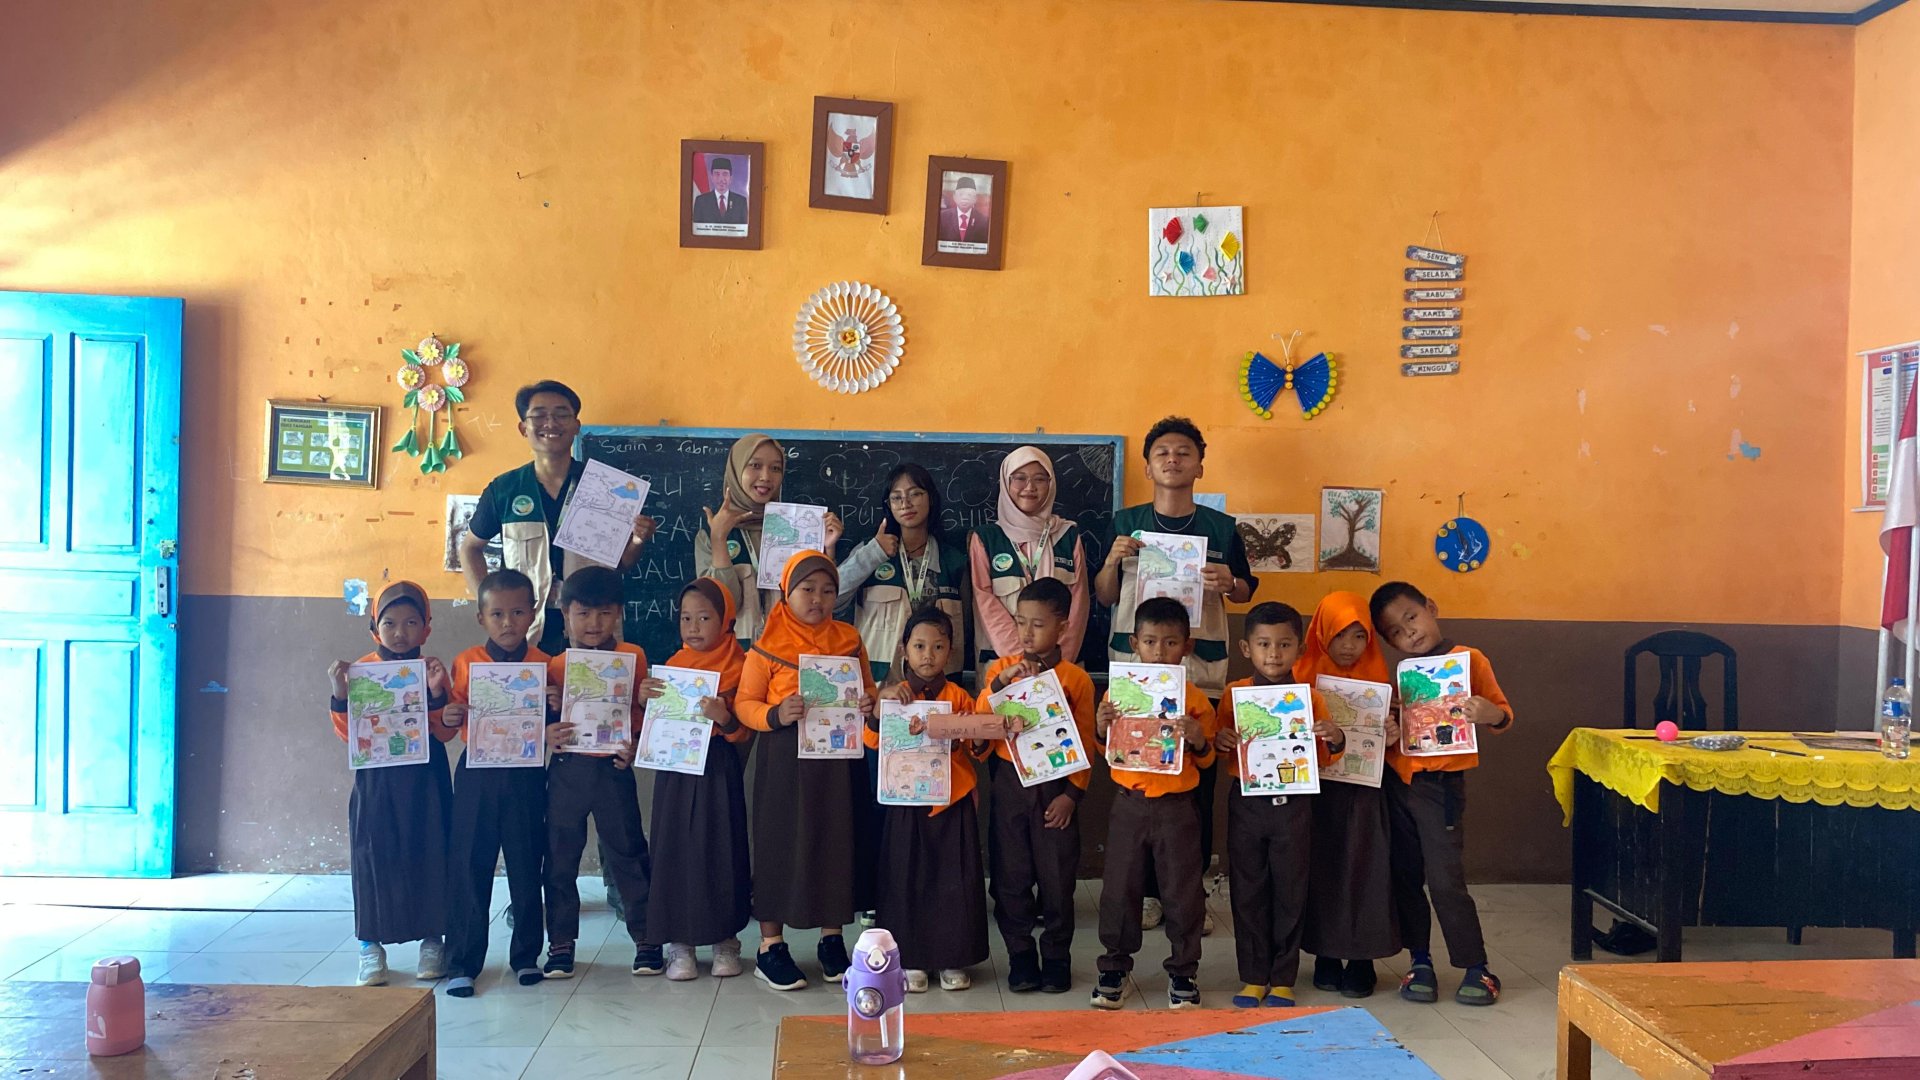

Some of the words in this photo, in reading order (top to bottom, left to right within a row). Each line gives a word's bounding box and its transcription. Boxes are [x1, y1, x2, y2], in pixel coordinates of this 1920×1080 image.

[1426, 252, 1449, 261] SENIN
[600, 439, 647, 454] Senin
[655, 443, 664, 453] 2
